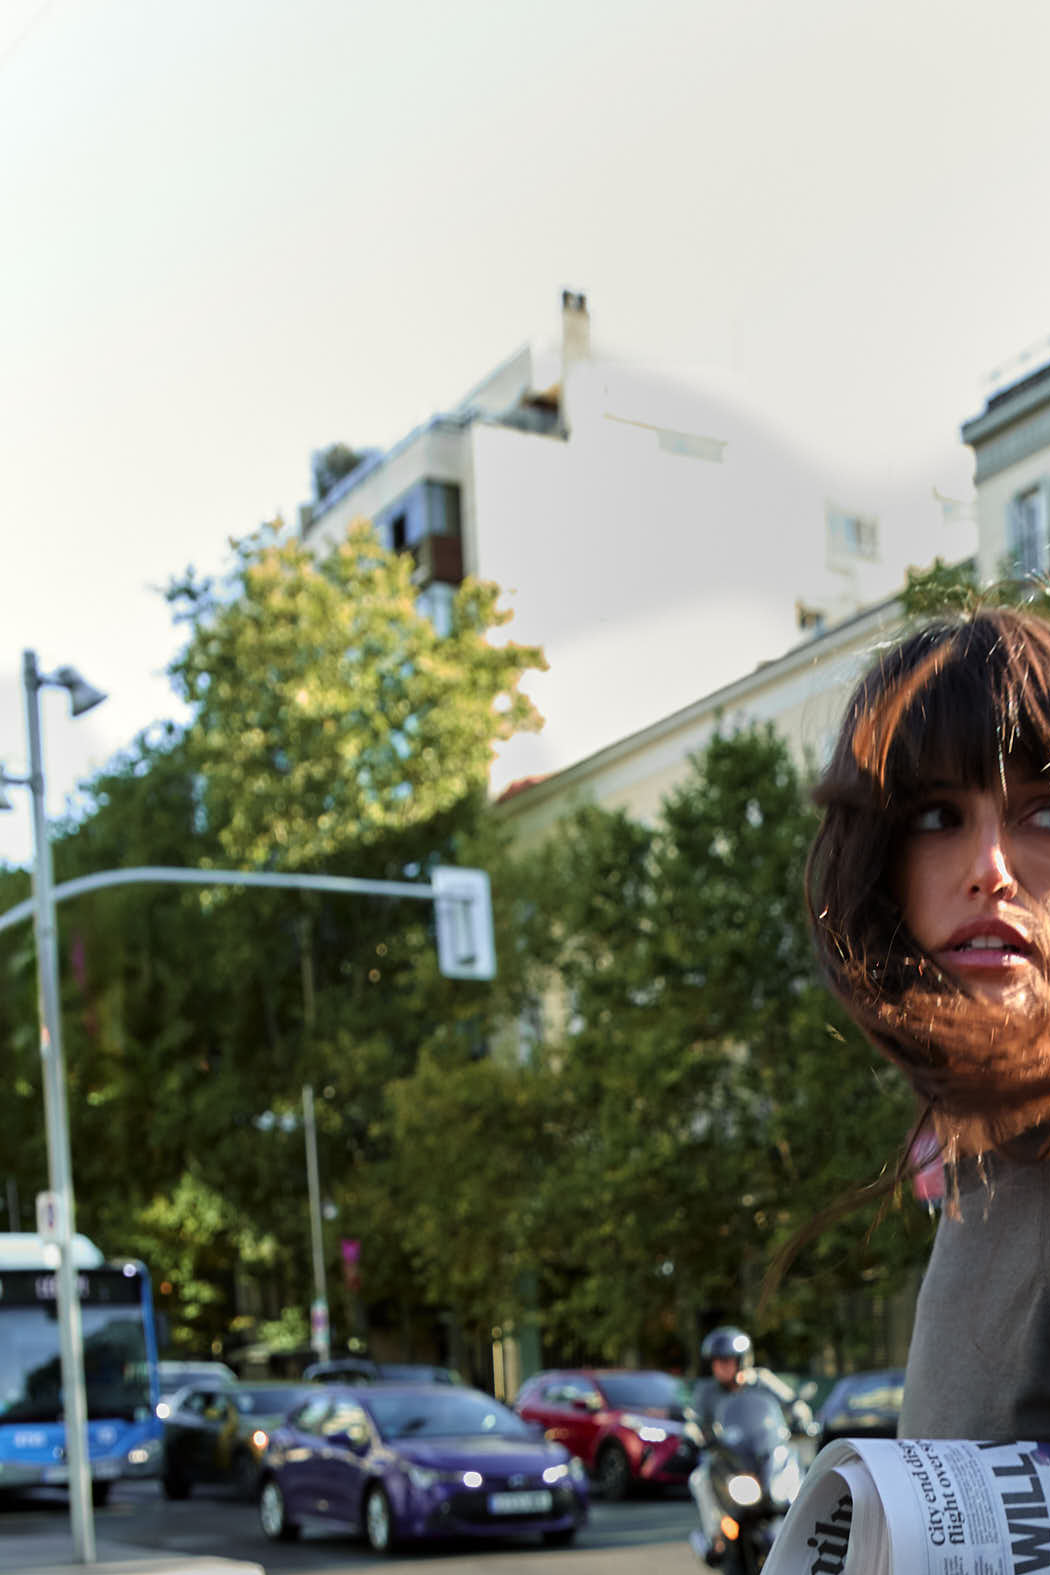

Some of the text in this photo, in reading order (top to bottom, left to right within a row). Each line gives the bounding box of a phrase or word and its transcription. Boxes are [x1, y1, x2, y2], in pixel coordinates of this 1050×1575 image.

[912, 1471, 937, 1503] end
[925, 1454, 951, 1488] over
[928, 1506, 946, 1546] City
[942, 1491, 965, 1545] flight
